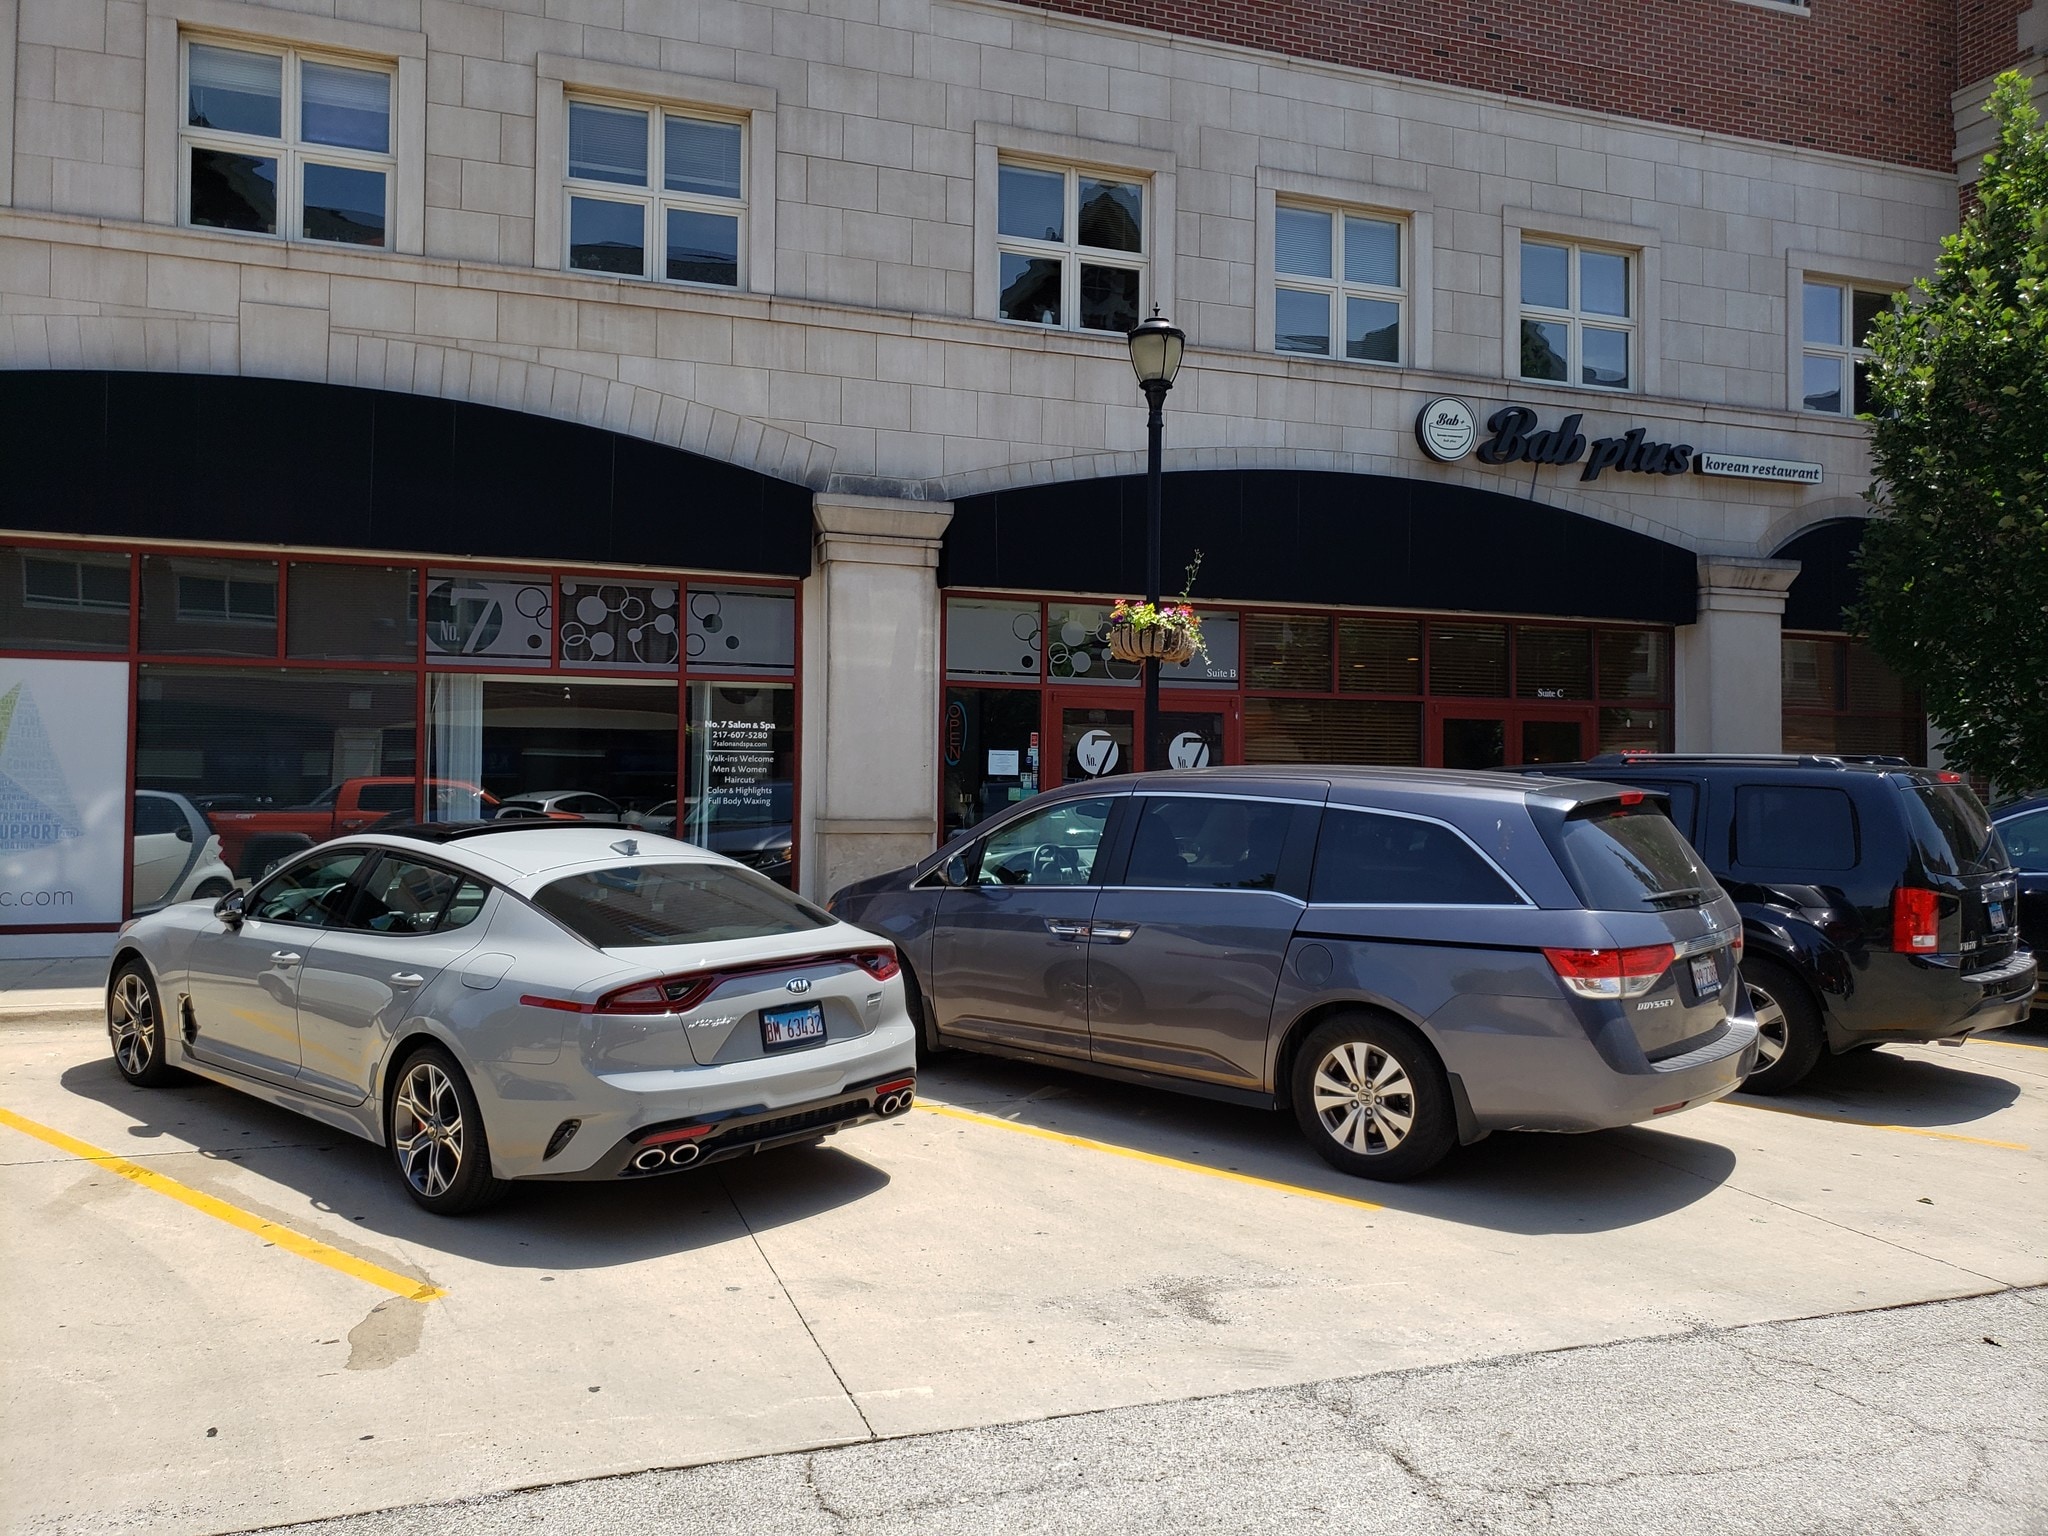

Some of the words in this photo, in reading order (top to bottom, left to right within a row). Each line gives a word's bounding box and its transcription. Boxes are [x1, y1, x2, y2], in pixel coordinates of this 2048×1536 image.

[1436, 413, 1459, 426] Bab
[1476, 406, 1586, 465] Bab
[1580, 427, 1693, 482] plus
[1705, 455, 1750, 473] korean
[1750, 461, 1820, 480] restaurant
[450, 587, 498, 654] 7
[440, 620, 461, 641] No.
[1206, 668, 1227, 678] Suite
[1229, 669, 1237, 678] B
[1537, 688, 1556, 698] Suite
[1557, 689, 1564, 698] C
[704, 720, 720, 728] No.
[728, 721, 751, 729] Salon
[760, 721, 776, 731] Spa
[712, 731, 768, 739] 217-607-5280
[947, 704, 961, 760] OPEN
[712, 740, 768, 748] 7salonandspa.com
[706, 754, 738, 762] Walk-ins
[739, 755, 774, 763] Welcome
[1085, 754, 1097, 767] No.
[1177, 756, 1189, 768] No.
[724, 776, 755, 784] Haircuts
[706, 786, 727, 794] Color
[735, 786, 772, 796] Highlights
[708, 797, 721, 805] Full
[722, 797, 742, 806] Body
[743, 798, 771, 807] Waxing
[790, 980, 808, 992] KIA
[1636, 998, 1675, 1011] ODYSSEY
[765, 1022, 782, 1042] BM
[786, 1014, 822, 1039] 63432
